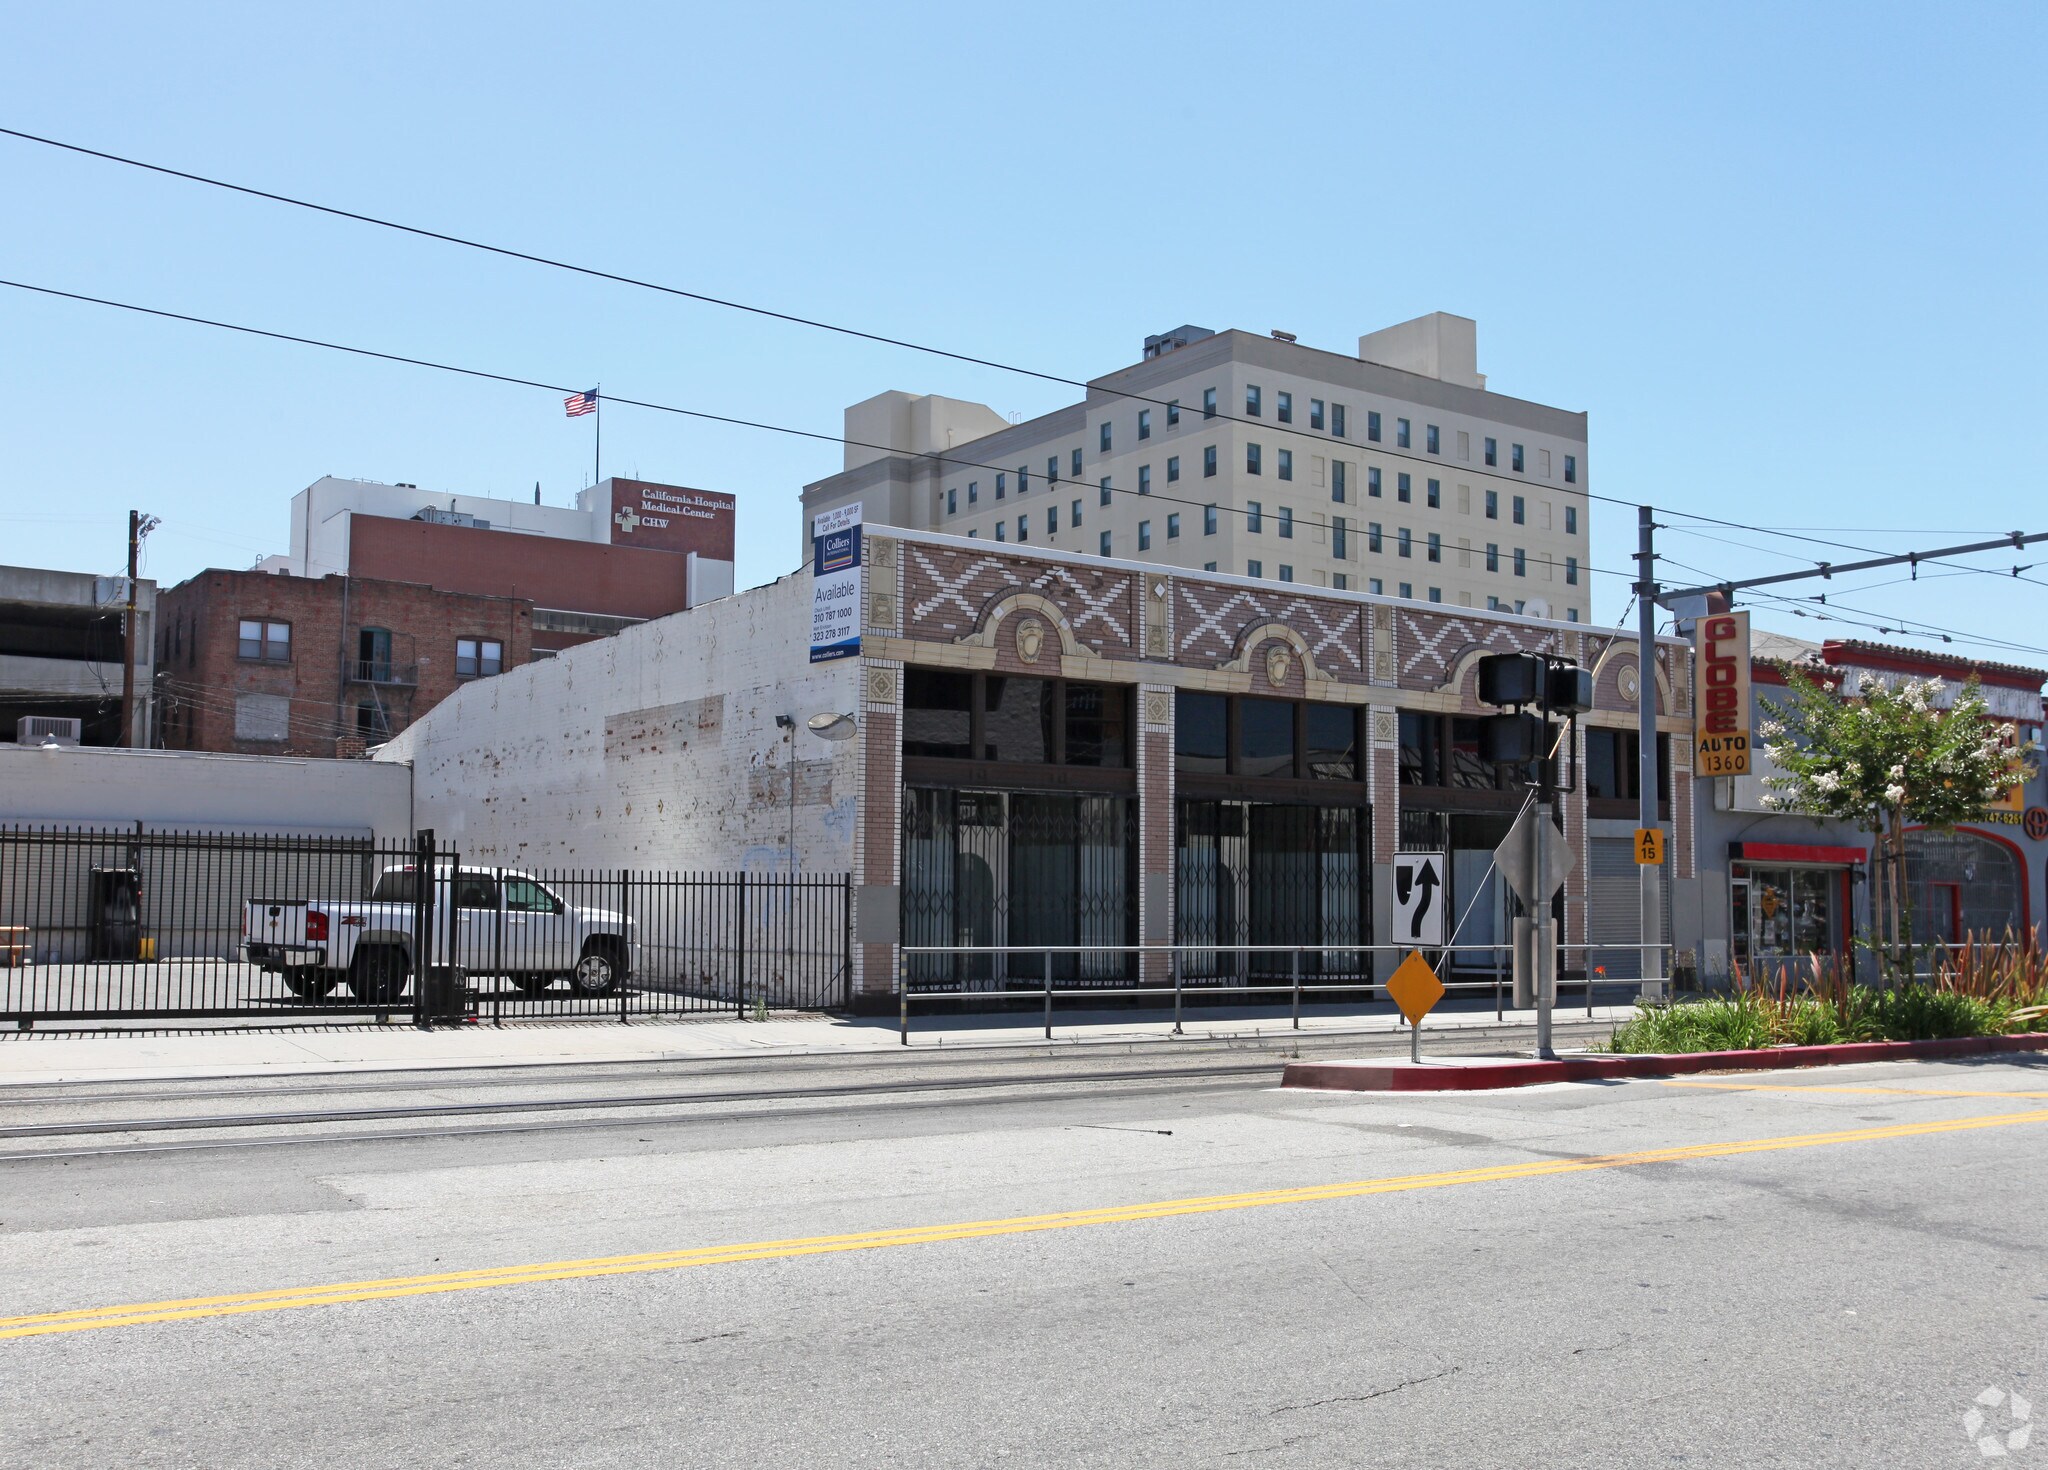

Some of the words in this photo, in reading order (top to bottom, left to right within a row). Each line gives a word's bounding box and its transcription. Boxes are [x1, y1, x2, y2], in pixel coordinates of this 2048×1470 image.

[642, 488, 691, 504] California
[694, 496, 735, 511] Hospital
[641, 501, 681, 515] Medical
[682, 506, 716, 520] Center
[641, 516, 669, 529] CHW
[837, 518, 850, 528] Details
[826, 538, 850, 551] Colliers
[814, 581, 855, 603] Available
[813, 613, 824, 624] 310
[825, 610, 836, 621] 787
[836, 606, 852, 618] 1000
[812, 631, 824, 642] 323
[824, 628, 836, 640] 278
[836, 625, 850, 637] 3117
[811, 650, 845, 660] www.colliers.com
[1705, 617, 1738, 734] GLOBE
[1699, 736, 1746, 753] AUTO
[1707, 755, 1745, 772] 1360
[1642, 830, 1655, 846] A
[1641, 847, 1656, 860] 15
